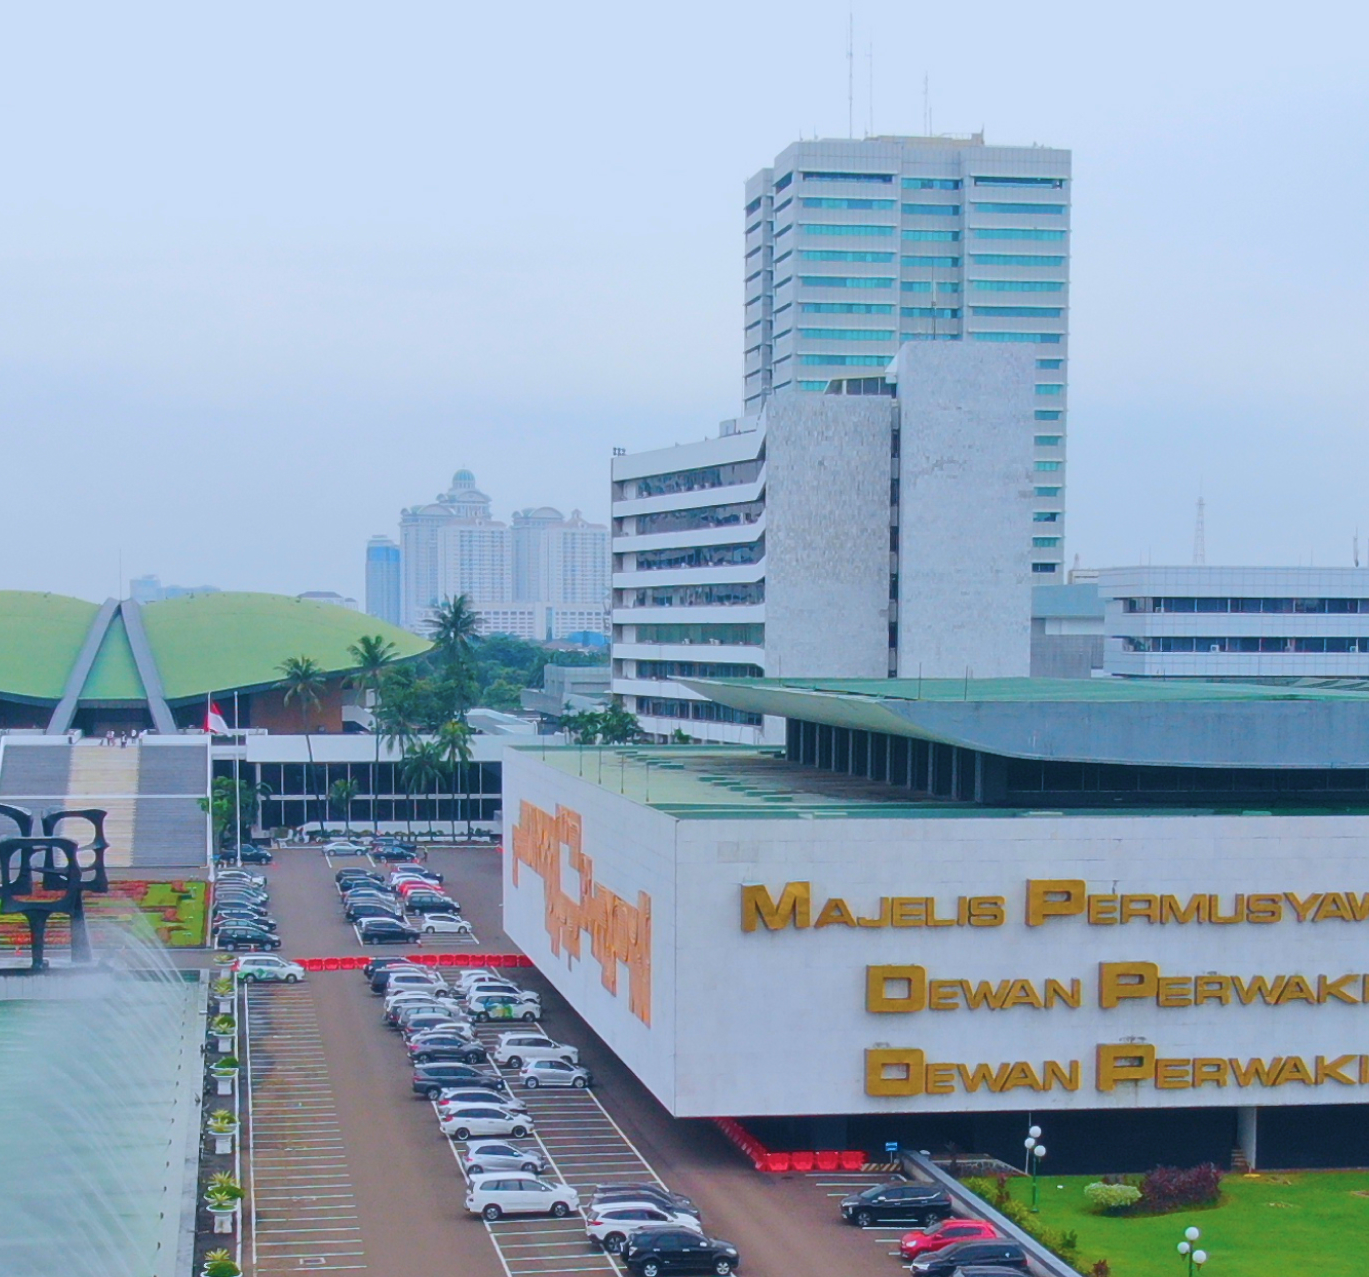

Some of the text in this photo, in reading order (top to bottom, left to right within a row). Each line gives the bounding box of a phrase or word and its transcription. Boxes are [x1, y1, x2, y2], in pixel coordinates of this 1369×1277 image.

[741, 880, 1007, 932] MAJELIS
[865, 964, 1082, 1014] DEWAN
[864, 1047, 1082, 1097] DEWAN
